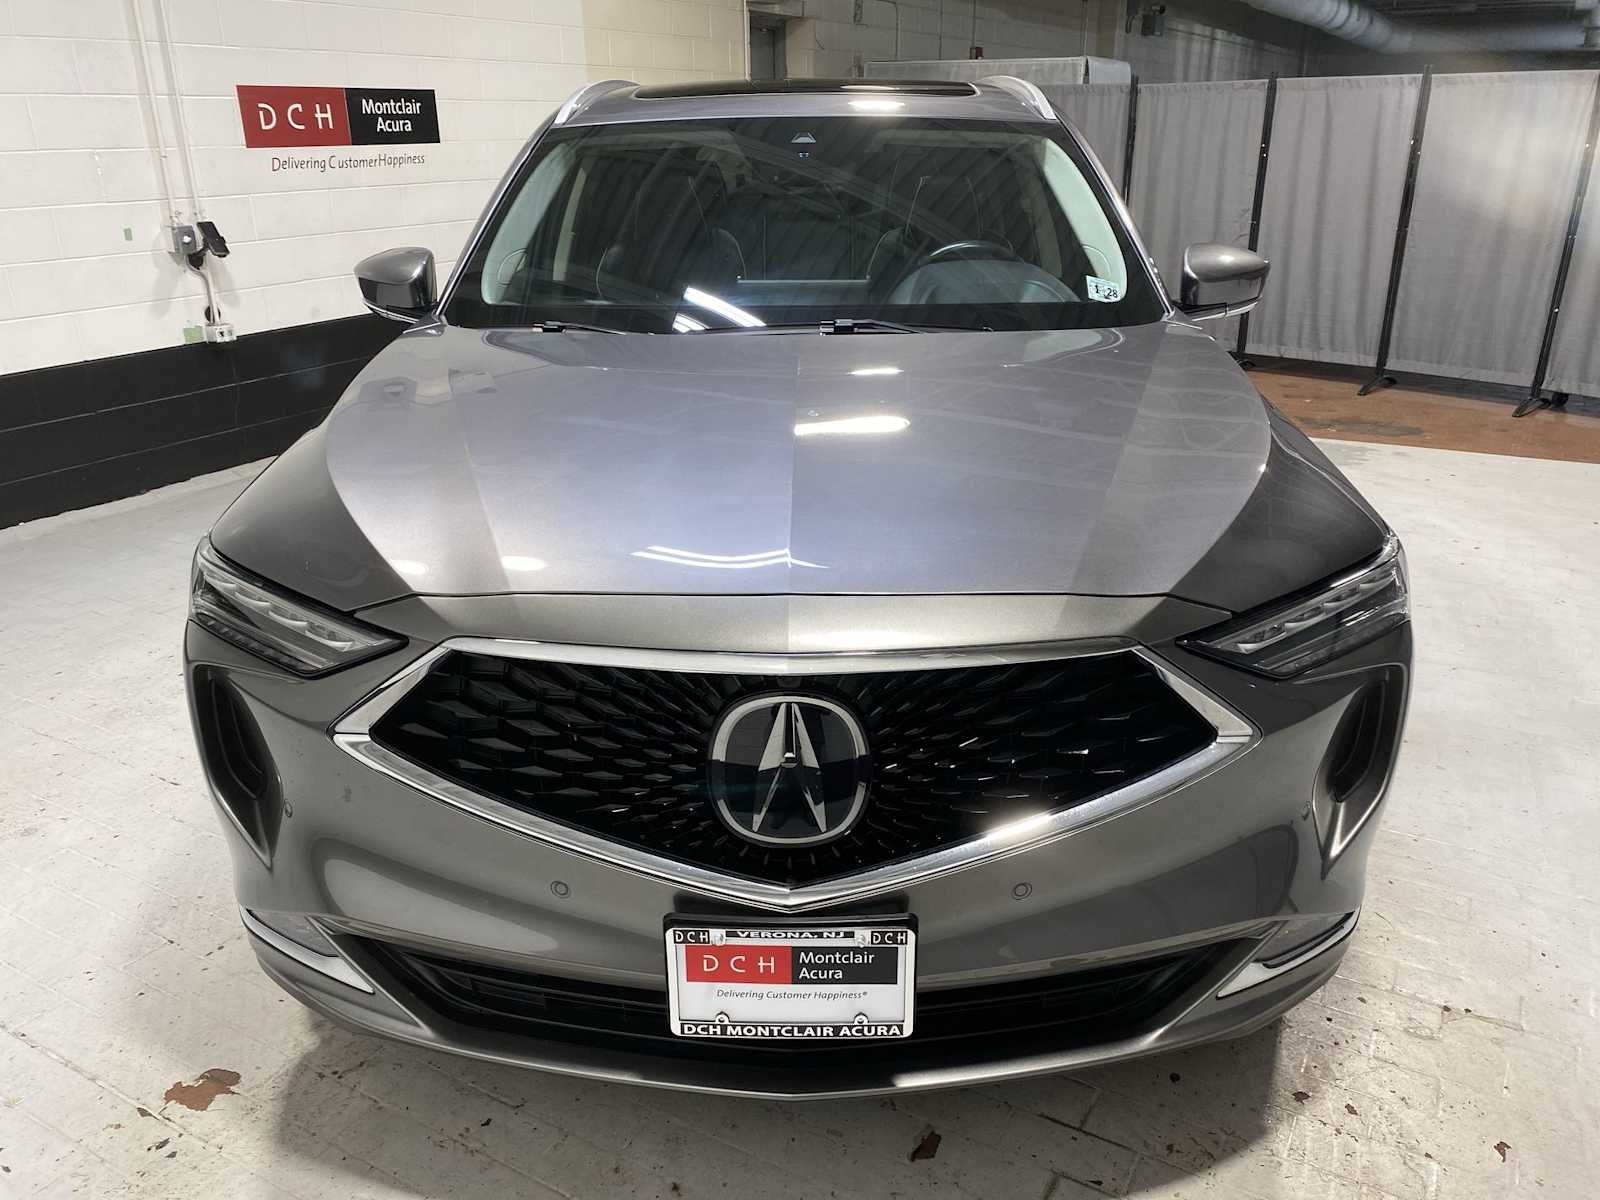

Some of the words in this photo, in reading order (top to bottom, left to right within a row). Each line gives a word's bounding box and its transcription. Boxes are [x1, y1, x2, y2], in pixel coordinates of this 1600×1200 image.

[361, 98, 421, 115] Montclair
[257, 103, 334, 131] DCH
[377, 116, 412, 132] Acura
[271, 155, 326, 173] Delivering
[328, 155, 378, 169] Customer
[378, 153, 425, 167] Happiness
[675, 930, 709, 943] DCH
[872, 932, 906, 944] DCH
[703, 954, 775, 974] DCH
[799, 951, 875, 964] Montclair
[799, 967, 843, 979] Acura
[716, 989, 764, 1000] Delivering
[766, 990, 811, 999] Customer
[683, 1024, 721, 1035] DCH
[726, 1026, 834, 1036] MONTCLAIR
[839, 1025, 901, 1036] ACURA
